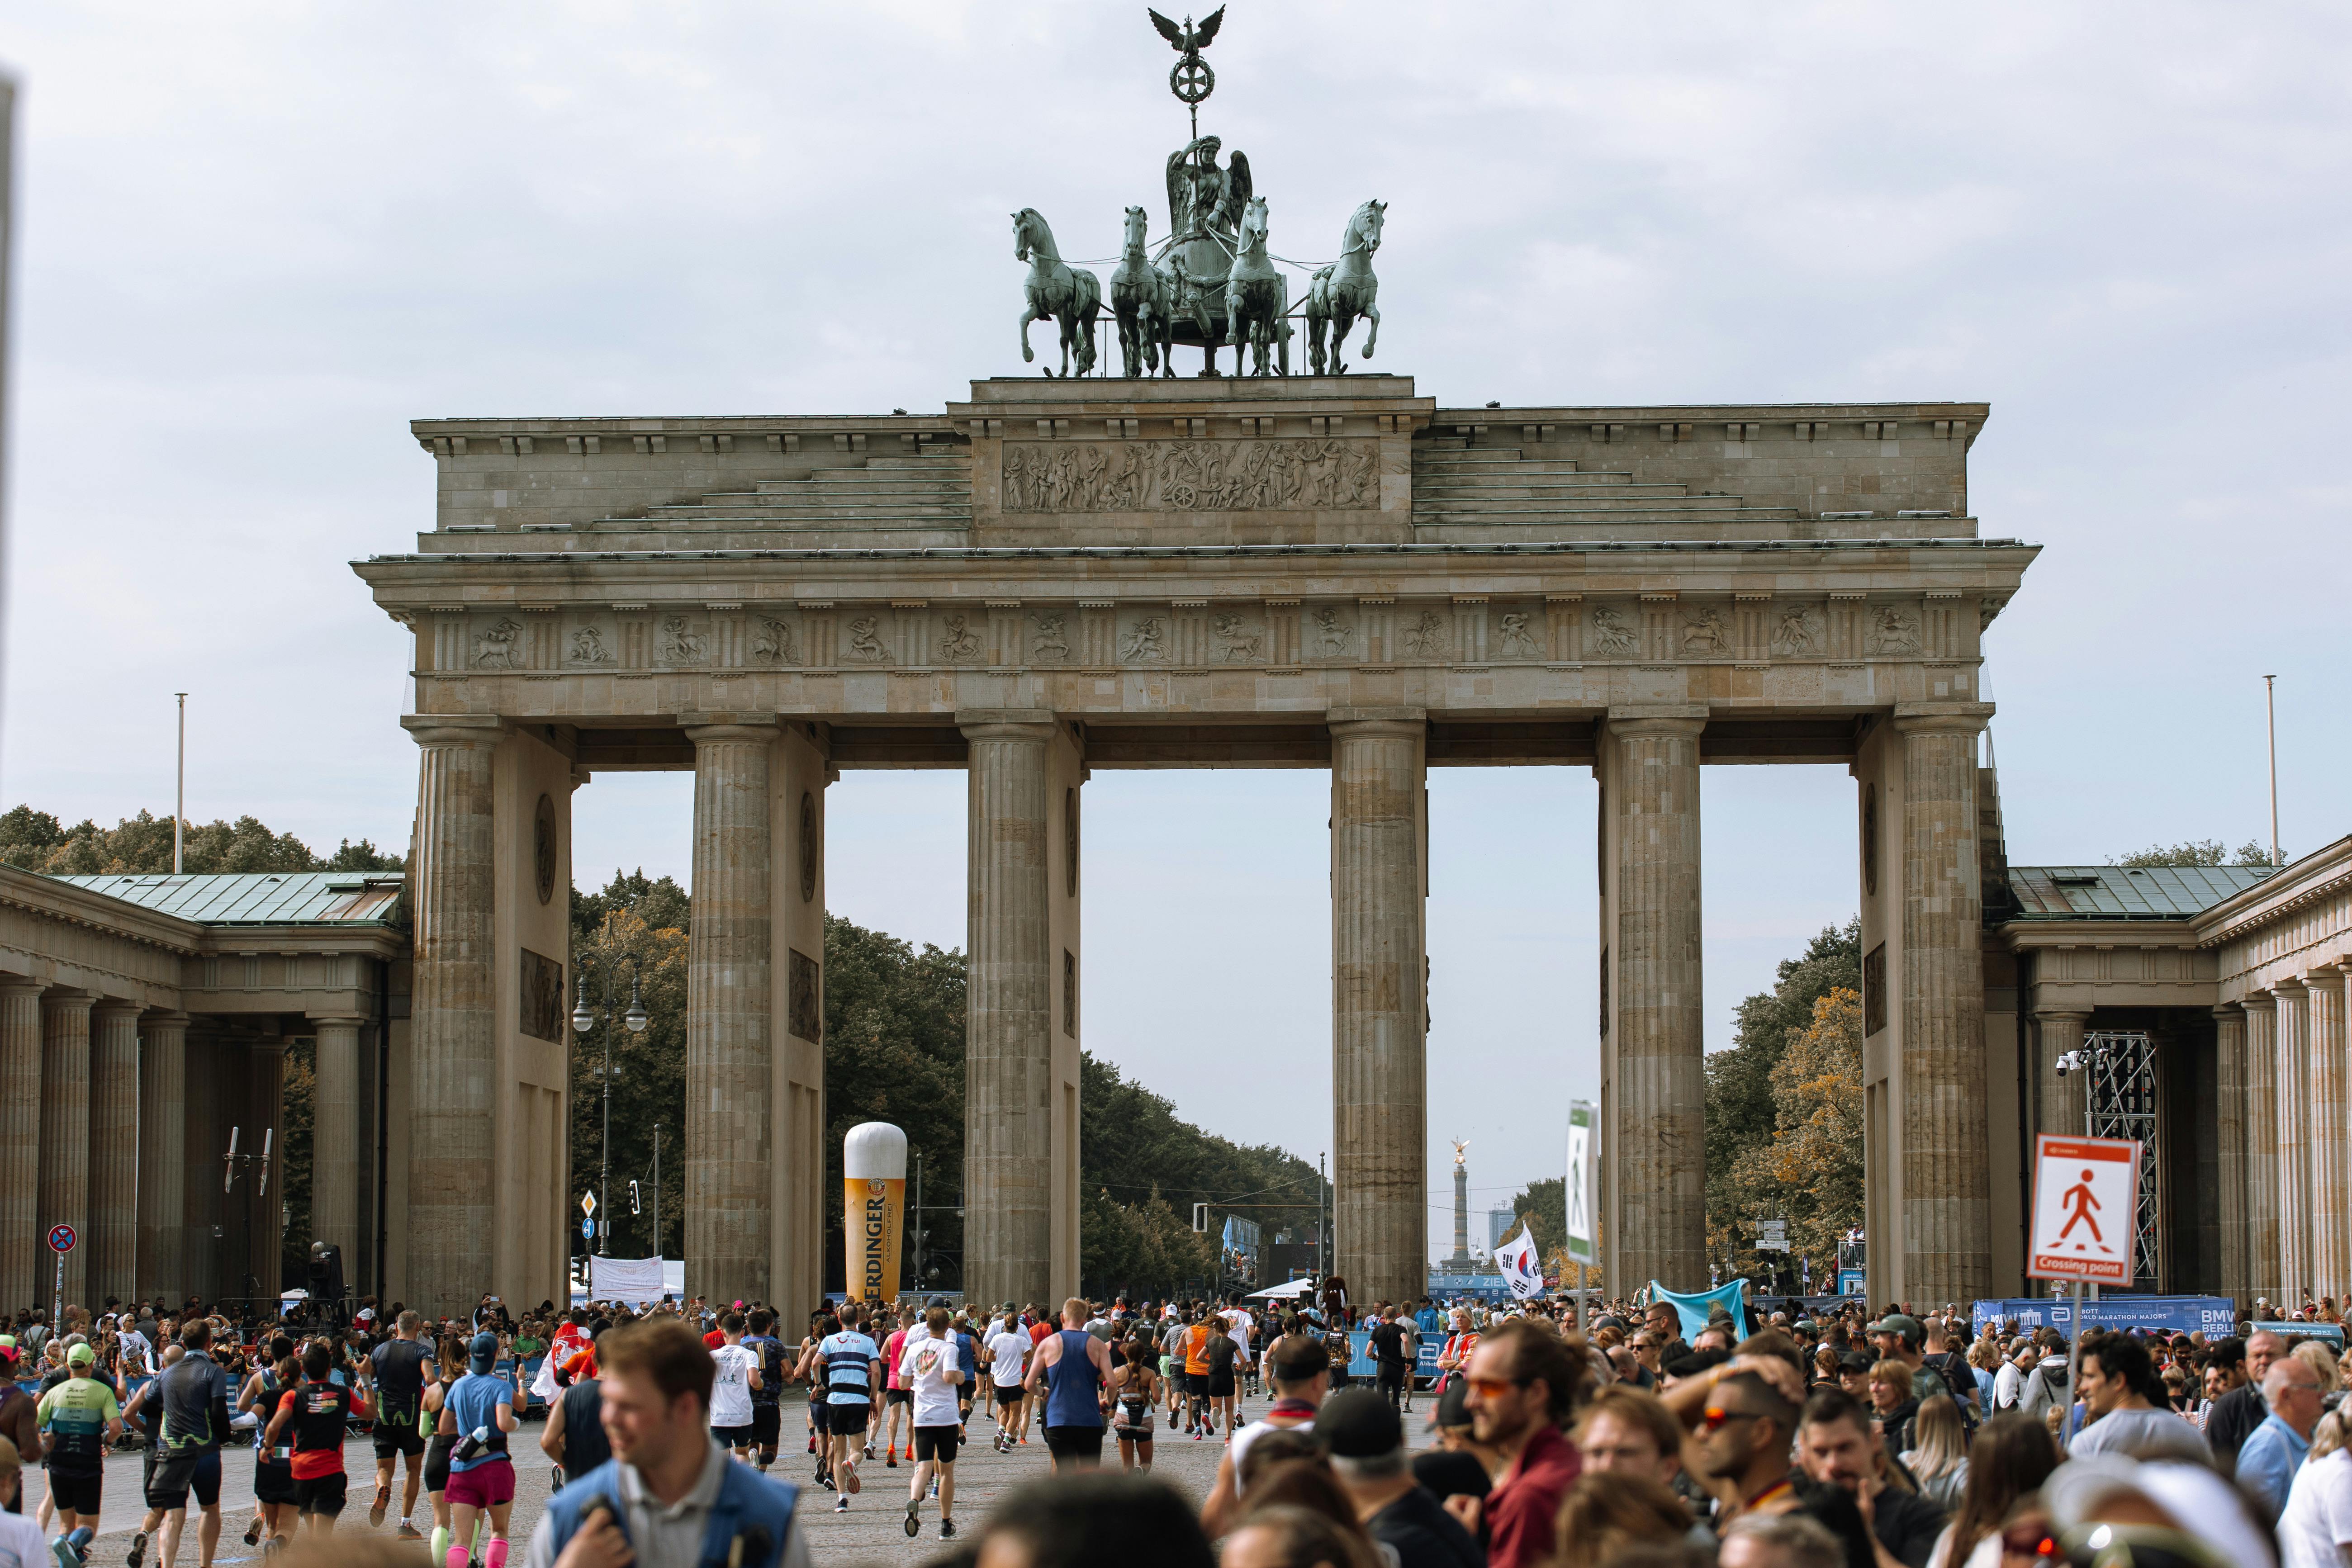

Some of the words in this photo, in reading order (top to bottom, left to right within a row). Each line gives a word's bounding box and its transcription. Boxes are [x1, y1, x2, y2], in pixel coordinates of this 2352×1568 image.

[865, 1196, 885, 1300] ERDINGER
[2039, 1256, 2087, 1273] Crossing
[2089, 1263, 2120, 1274] point
[1483, 1277, 1507, 1287] ZIEL
